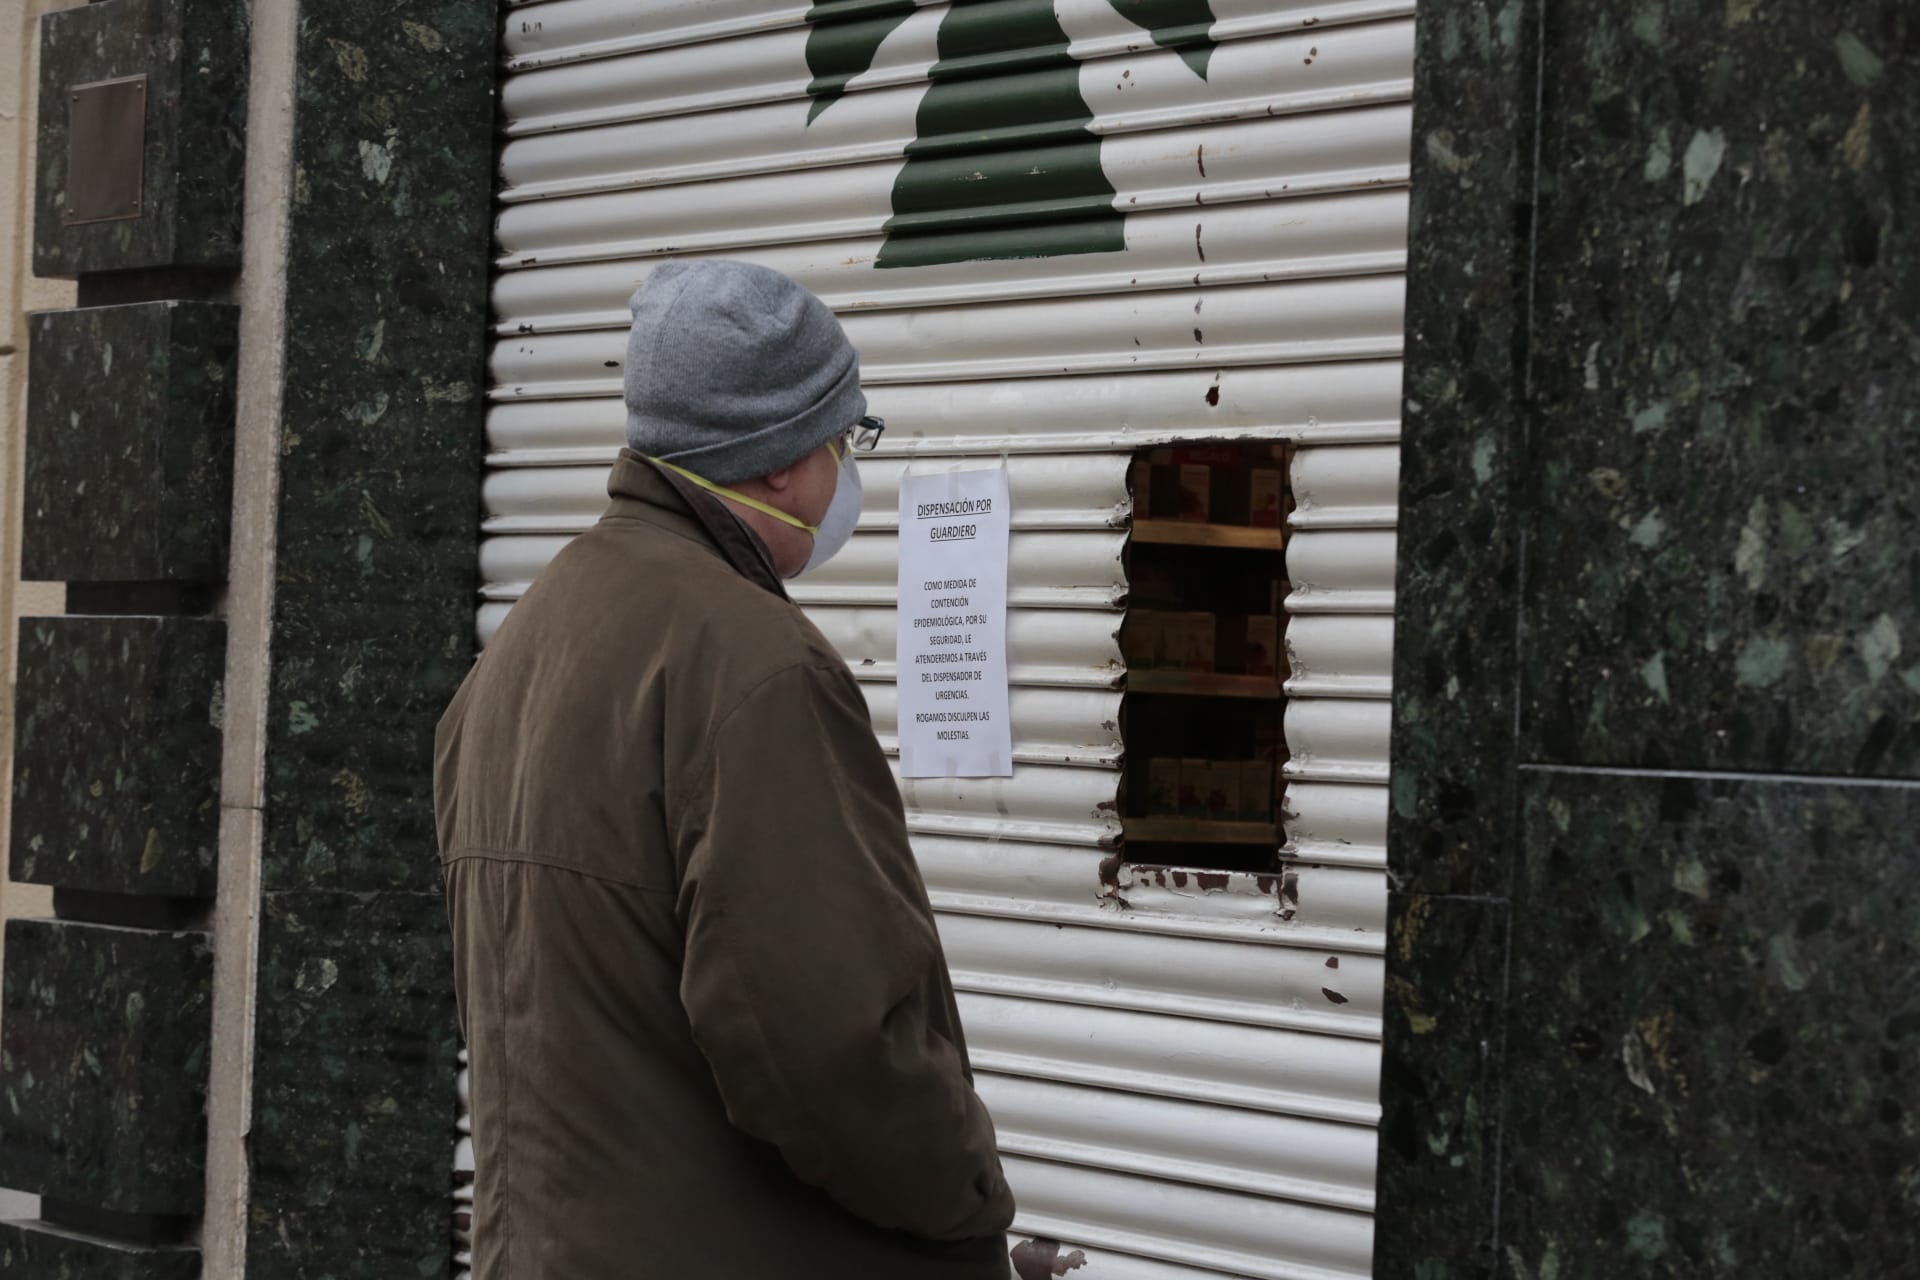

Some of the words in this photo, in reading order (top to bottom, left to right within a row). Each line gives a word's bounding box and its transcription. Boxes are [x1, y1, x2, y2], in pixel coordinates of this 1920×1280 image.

[917, 498, 975, 516] DISPENSACIÓN
[976, 499, 992, 511] POR
[930, 524, 977, 539] GUARDIERO
[924, 581, 942, 591] COMO
[943, 579, 967, 590] MEDIDA
[969, 578, 977, 588] DE
[931, 595, 969, 609] CONTENCIÓN
[914, 615, 964, 628] EPIDEMIOLÓGICA,
[966, 615, 977, 625] POR
[978, 614, 987, 624] SU
[929, 634, 964, 645] SEGURIDAD,
[965, 634, 972, 644] LE
[915, 653, 958, 664] ATENDEREMOS
[959, 653, 964, 662] A
[965, 650, 987, 662] TRAVÉS
[921, 673, 932, 683] DEL
[933, 671, 973, 682] DISPENSADOR
[974, 670, 982, 680] DE
[935, 690, 969, 700] URGENCIAS.
[916, 713, 947, 723] ROGAMOS
[948, 712, 978, 722] DISCULPEN
[979, 711, 990, 721] LAS
[937, 730, 970, 740] MOLESTIAS.
